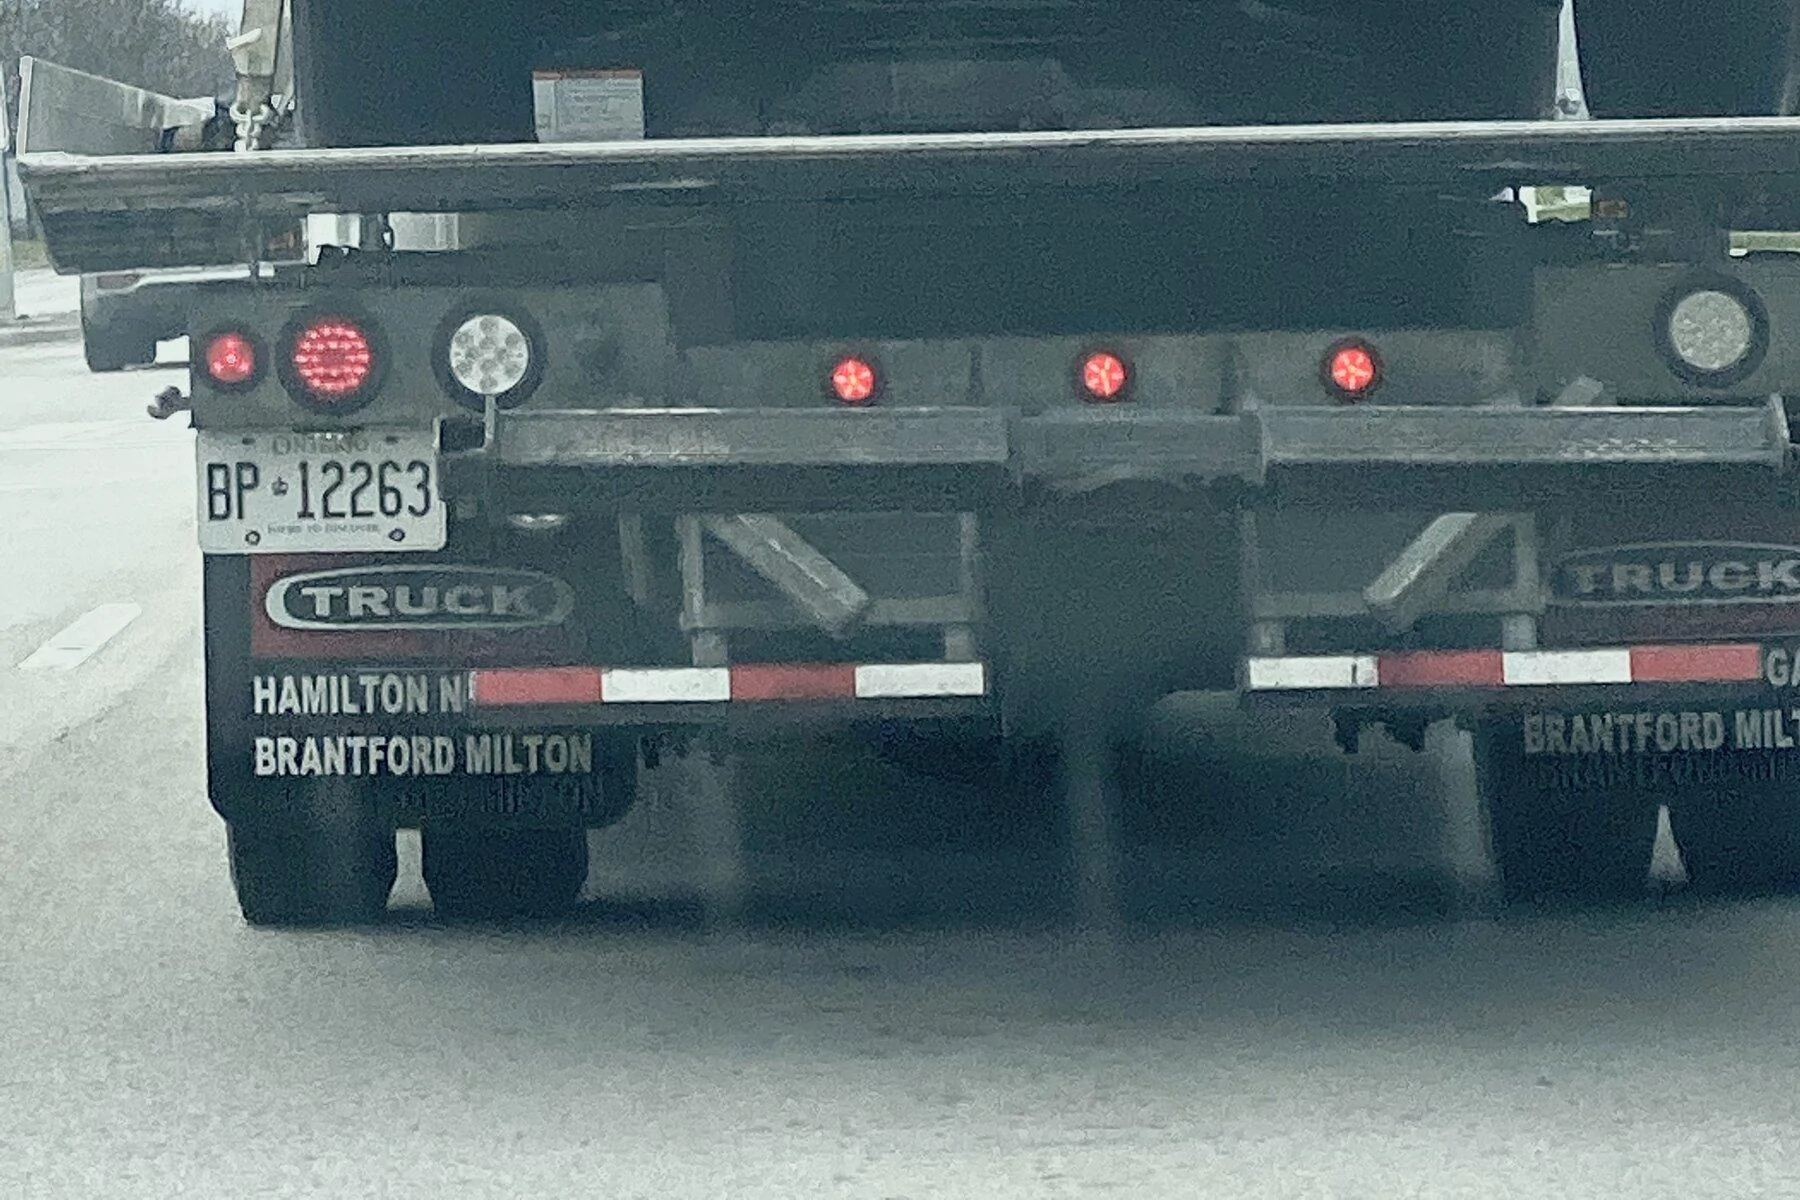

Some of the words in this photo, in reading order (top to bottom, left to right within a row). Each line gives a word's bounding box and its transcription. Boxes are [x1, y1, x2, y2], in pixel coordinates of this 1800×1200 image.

[207, 462, 260, 520] BP
[297, 460, 431, 518] 12263
[1570, 559, 1800, 592] TRUCK
[300, 585, 535, 616] TRUCK
[254, 673, 428, 714] HAMILTON
[1523, 711, 1725, 753] BRANTFORD
[254, 735, 455, 776] BRANTFORD
[465, 733, 592, 774] MILTON
